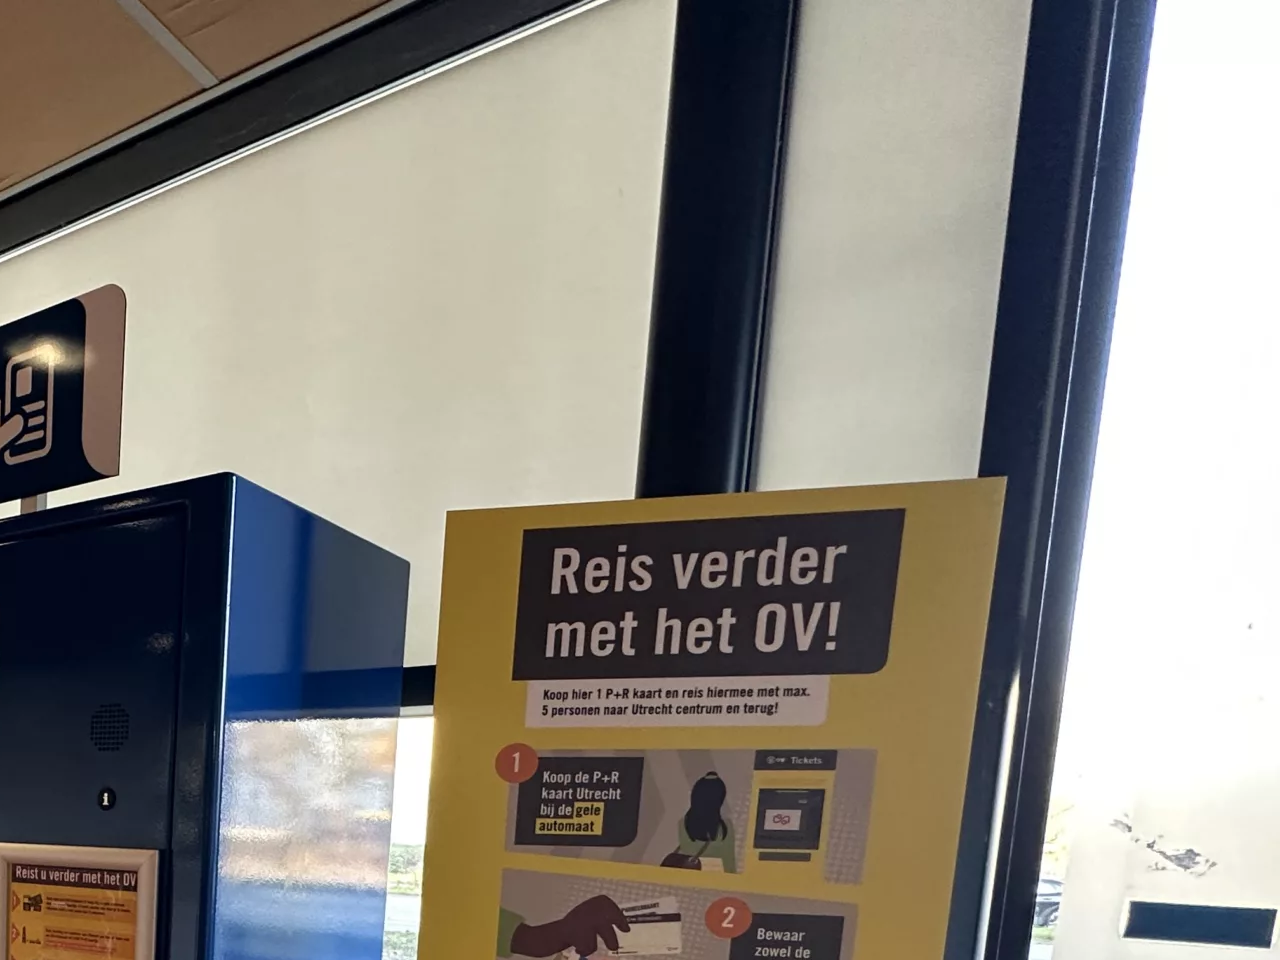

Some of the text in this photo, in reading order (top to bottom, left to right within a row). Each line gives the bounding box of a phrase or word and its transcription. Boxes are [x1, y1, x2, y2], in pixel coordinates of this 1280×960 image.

[551, 536, 848, 595] Reis verder
[545, 601, 841, 657] met het OV!
[543, 686, 810, 701] Koop hier 1 P+R kaart en reis hiermee met max.
[542, 702, 778, 718] 5 personen naar Utrecht centrum en terug!
[512, 752, 520, 773] 1
[543, 771, 619, 785] Koop de P+R
[542, 788, 621, 800] kaart Utrecht
[540, 804, 601, 818] bij de gele
[539, 821, 594, 832] automaat
[16, 866, 137, 887] Reist u verder met het OV
[722, 907, 736, 928] 2
[12, 928, 16, 937] 2
[757, 928, 806, 941] Bewaar
[755, 946, 810, 958] zowel de
